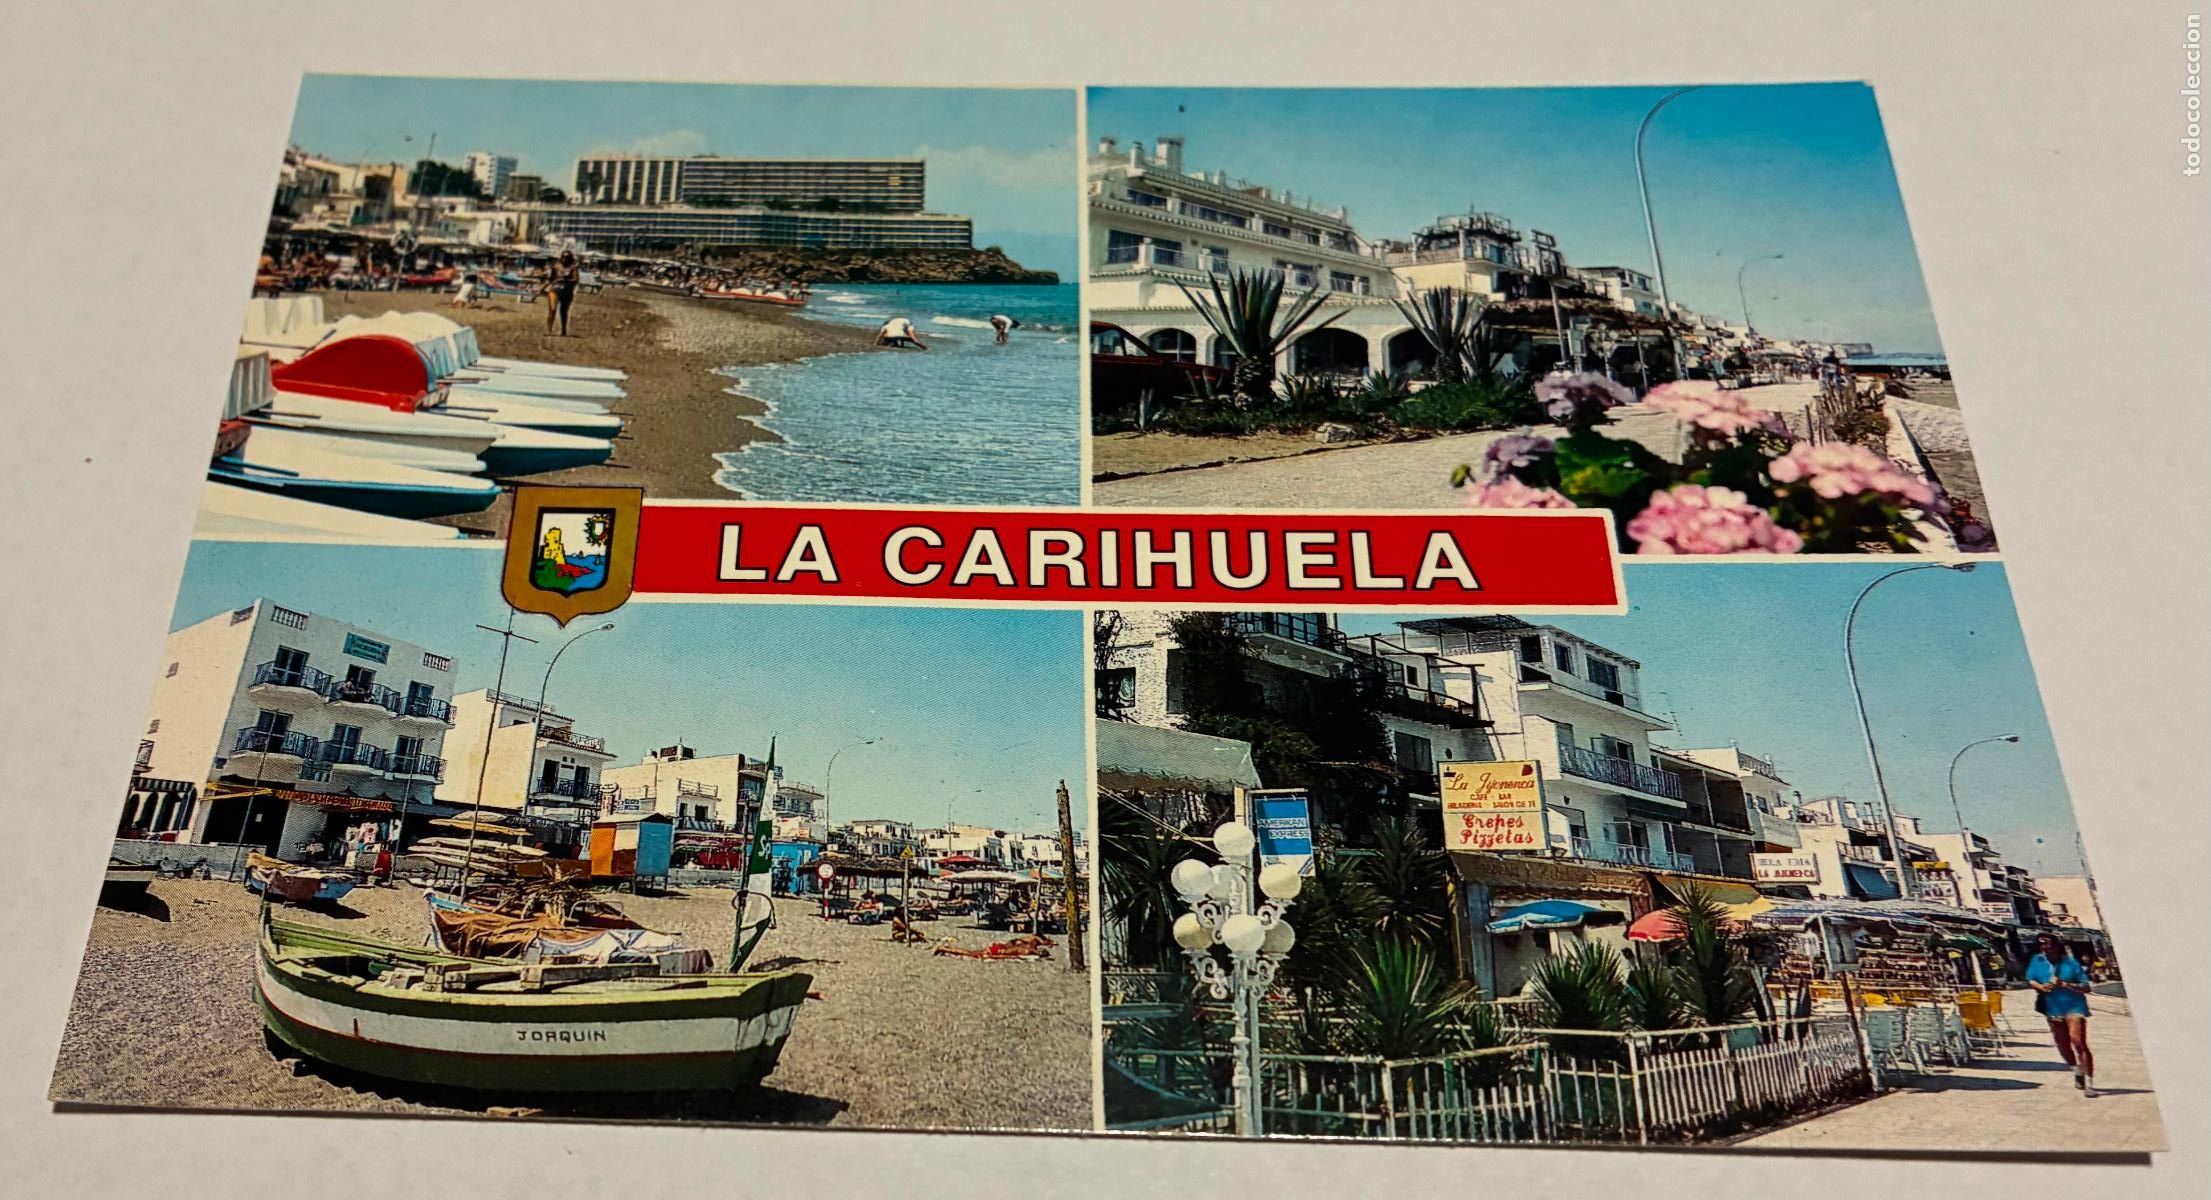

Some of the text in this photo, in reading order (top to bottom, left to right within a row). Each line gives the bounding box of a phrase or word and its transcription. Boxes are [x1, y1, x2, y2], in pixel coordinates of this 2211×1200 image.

[716, 523, 1483, 592] LA CARIHUELA
[1446, 773, 1469, 791] La
[1258, 817, 1307, 829] AMERICAN
[1462, 813, 1524, 833] Crepes
[1268, 828, 1311, 840] EXPRESS
[1460, 828, 1534, 848] Pizzetas
[517, 1029, 607, 1044] JOAQUIN
